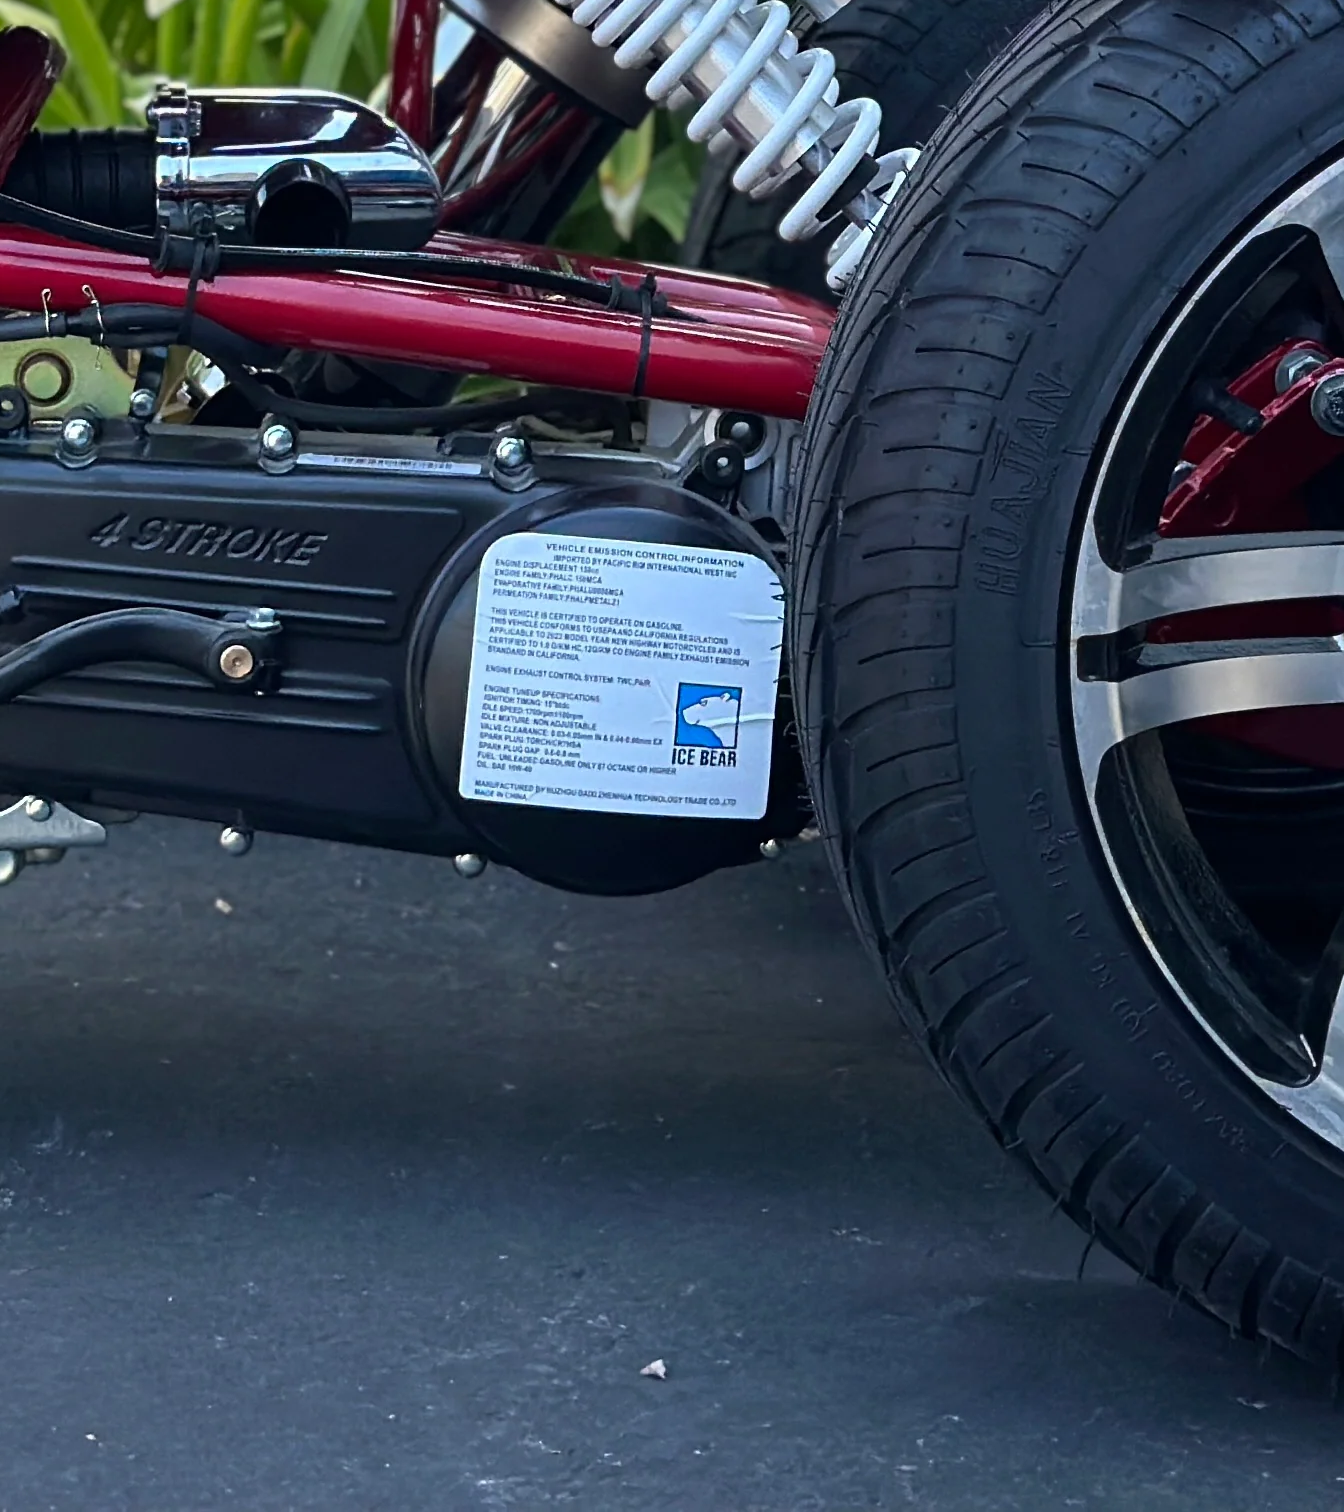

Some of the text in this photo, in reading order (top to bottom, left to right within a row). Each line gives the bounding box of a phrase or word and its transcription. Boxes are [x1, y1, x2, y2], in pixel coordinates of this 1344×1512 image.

[974, 371, 1074, 597] HUAJIAN
[88, 510, 329, 567] 4 STROKE
[495, 559, 522, 568] ENGINE
[523, 560, 577, 573] DISPLACEMENT
[546, 543, 745, 569] VEHICLE EMISSION CONTROL INFORMATION
[553, 554, 591, 566] IMPORTED
[592, 557, 602, 566] BY
[603, 558, 631, 569] PACIFIC
[646, 561, 703, 576] INTERNATIONAL
[704, 568, 724, 578] WEST
[494, 568, 521, 578] ENGINE
[492, 588, 538, 600] PERMEATION
[493, 578, 542, 590] EVAPORATIVE
[491, 606, 508, 616] THIS
[508, 608, 539, 619] VEHICLE
[540, 610, 548, 620] IS
[548, 612, 587, 623] CERTIFIED
[588, 615, 598, 624] TO
[599, 616, 632, 627] OPERATE
[633, 619, 644, 628] ON
[489, 626, 534, 638] APPLICABLE
[536, 630, 546, 639] TO
[564, 633, 589, 643] MODEL
[590, 635, 612, 645] YEAR
[612, 637, 628, 646] NEW
[629, 639, 662, 649] HIGHWAY
[663, 642, 717, 654] MOTORCYCLES
[717, 646, 733, 655] AND
[733, 648, 741, 656] IS
[490, 616, 507, 626] THIS
[507, 618, 539, 629] VEHICLE
[539, 621, 581, 633] CONFORMS
[582, 624, 592, 634] TO
[634, 629, 678, 641] CALIFORNIA
[678, 633, 729, 646] REGULATIONS
[487, 645, 526, 657] STANDARD
[527, 649, 535, 657] IN
[488, 635, 527, 648] CERTIFIED
[528, 639, 539, 648] TO
[612, 646, 623, 656] CO
[624, 648, 652, 659] ENGINE
[653, 651, 679, 661] FAMILY
[680, 653, 714, 664] EXHAUST
[715, 656, 750, 668] EMISSION
[485, 664, 512, 675] ENGINE
[513, 667, 547, 678] EXHAUST
[548, 670, 582, 682] CONTROL
[484, 684, 511, 694] ENGINE
[484, 694, 515, 704] IGNITION
[482, 703, 498, 712] IDLE
[481, 712, 497, 721] IDLE
[533, 718, 549, 727] NON
[550, 720, 597, 732] ADJUSTABLE
[479, 731, 503, 741] SPARK
[480, 722, 502, 732] VALVE
[652, 737, 663, 746] EX
[478, 741, 502, 751] SPARK
[503, 744, 523, 753] PLUG
[499, 753, 538, 765] UNLEADED
[539, 756, 576, 768] GASOLINE
[577, 760, 596, 769] ONLY
[606, 763, 636, 773] OCTANE
[637, 765, 648, 774] OR
[649, 766, 676, 776] HIGHER
[671, 748, 737, 768] ICE BEAR
[474, 789, 494, 797] MADE
[475, 779, 534, 792] MANUFACTURED
[535, 784, 545, 793] BY
[634, 793, 683, 805] TECHNOLOGY
[684, 796, 708, 805] TRADE
